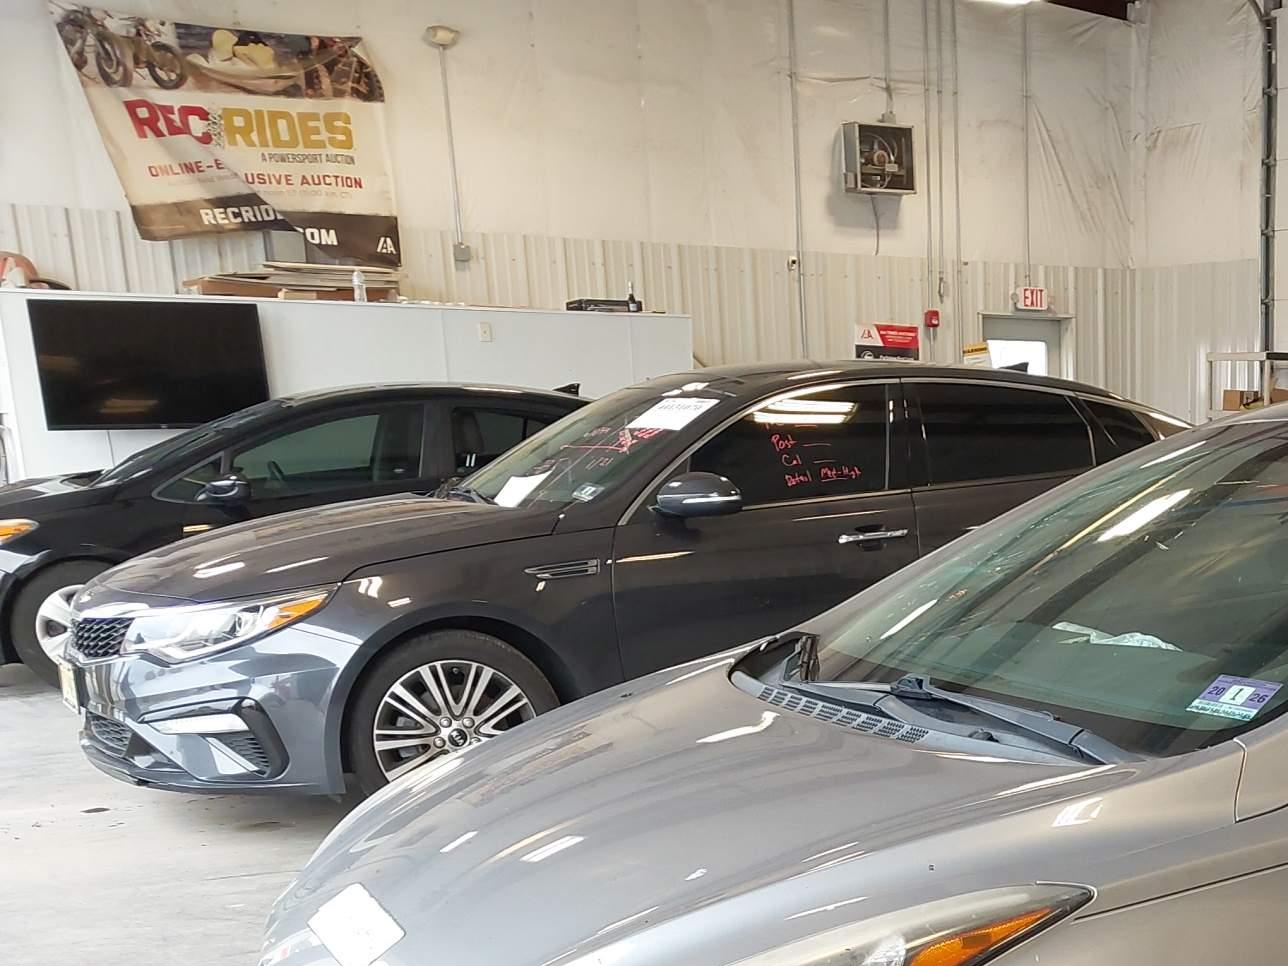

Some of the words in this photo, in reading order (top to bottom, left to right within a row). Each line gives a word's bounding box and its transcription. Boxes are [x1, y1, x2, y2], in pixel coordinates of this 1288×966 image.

[222, 107, 354, 151] RIDES
[261, 152, 267, 163] A
[268, 152, 322, 163] POWERSPORT
[325, 153, 355, 165] AUCTION
[300, 174, 363, 189] AUCTION
[1023, 288, 1044, 307] EXIT
[771, 434, 797, 452] Post
[1208, 686, 1226, 696] 20
[1249, 693, 1269, 703] 26
